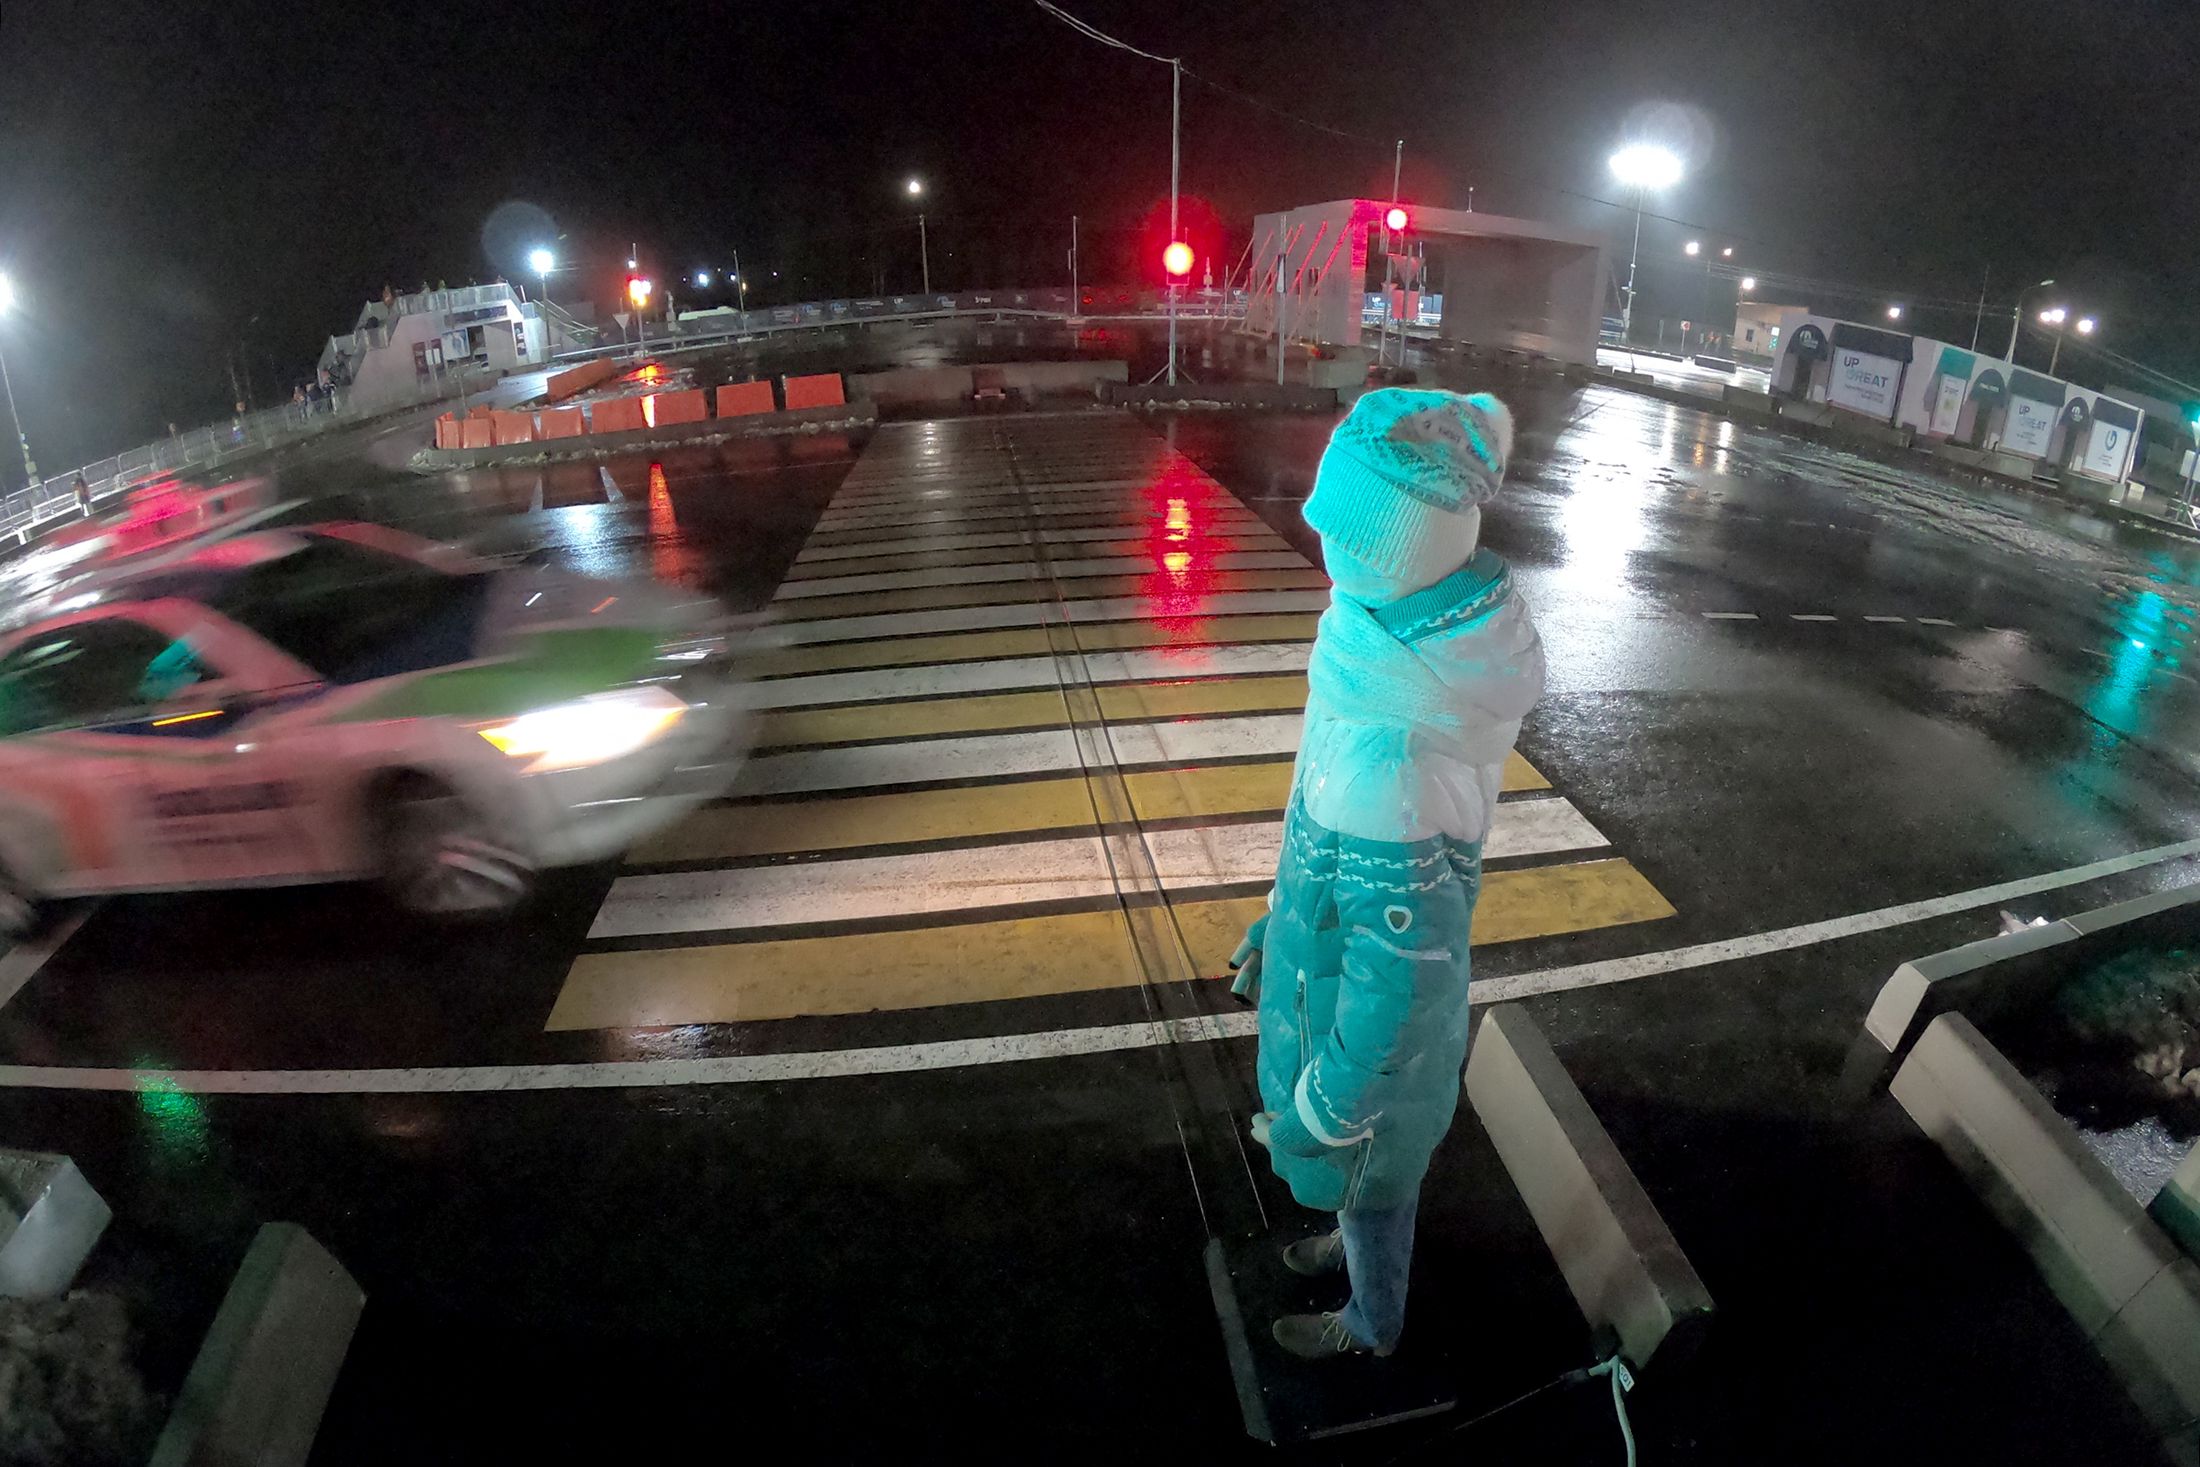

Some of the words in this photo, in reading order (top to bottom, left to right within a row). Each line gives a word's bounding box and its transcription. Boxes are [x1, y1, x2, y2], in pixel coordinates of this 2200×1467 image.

[1844, 356, 1860, 368] UP
[1846, 369, 1888, 388] GREAT
[2019, 405, 2030, 415] UP
